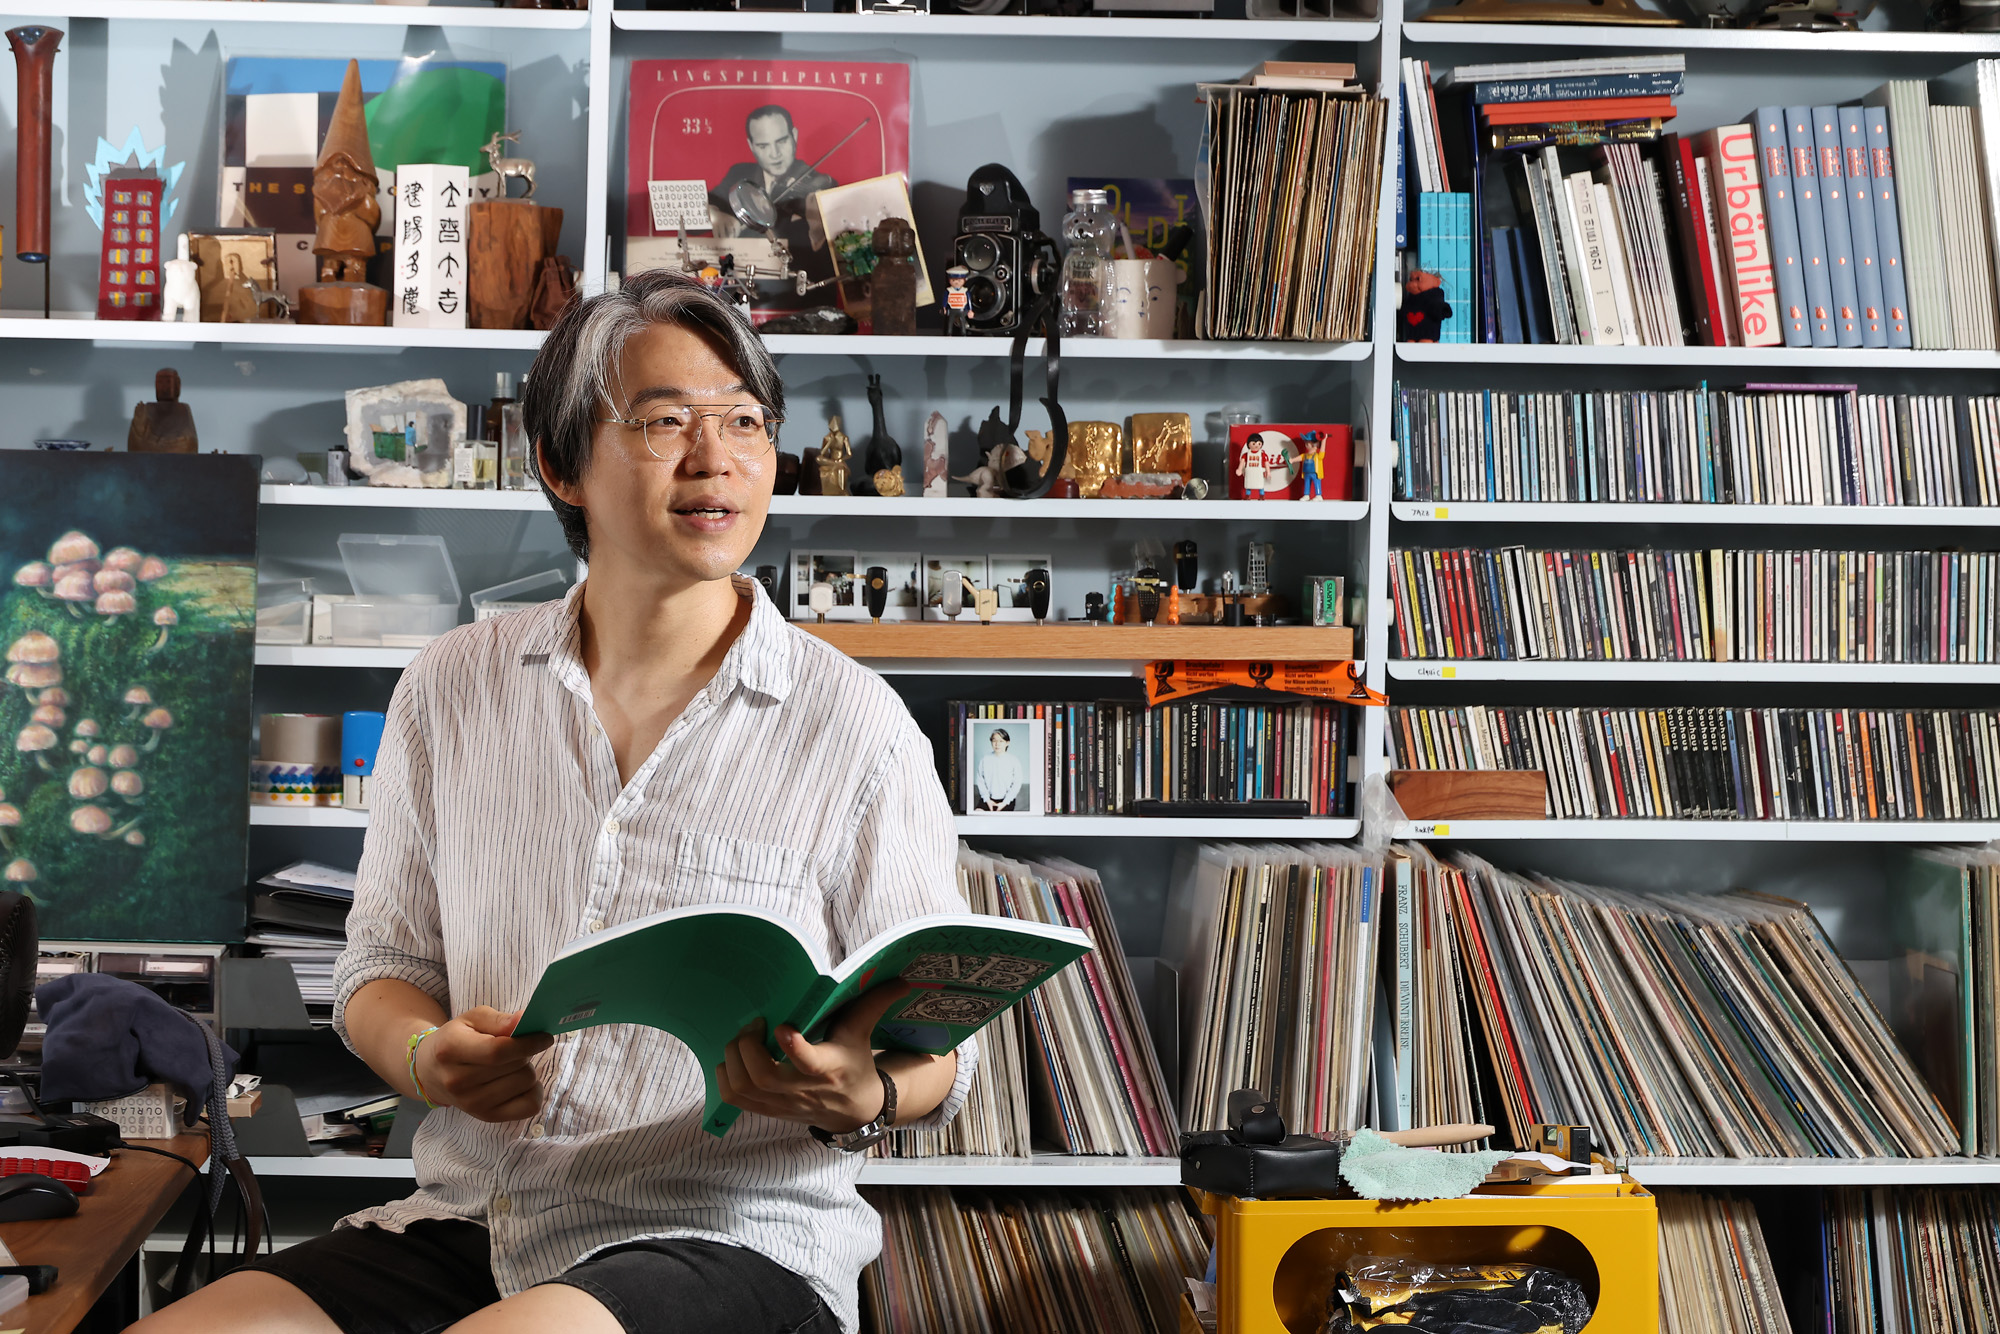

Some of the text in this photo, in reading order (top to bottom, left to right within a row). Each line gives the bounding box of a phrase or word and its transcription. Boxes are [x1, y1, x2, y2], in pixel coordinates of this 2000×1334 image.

[657, 69, 884, 85] LANGSPIELPLATTE
[233, 182, 279, 194] THE
[654, 201, 707, 210] OURLABOUR
[1720, 132, 1777, 336] Urbänlike
[1326, 582, 1334, 611] MARVIS
[1479, 728, 1490, 750] Moreau
[1498, 712, 1509, 743] BAUHAUS
[1517, 714, 1527, 739] CODEINE
[1659, 714, 1668, 744] BAUHAUS
[1666, 708, 1679, 750] bauhaus
[1676, 708, 1689, 751] bauhaus
[1686, 709, 1699, 751] bauhaus
[1698, 708, 1710, 751] bauhaus
[1707, 708, 1718, 750] bauhaus
[1717, 707, 1728, 751] bauhaus
[1398, 884, 1407, 914] FRANZ
[1398, 922, 1407, 969] SCHUBERT
